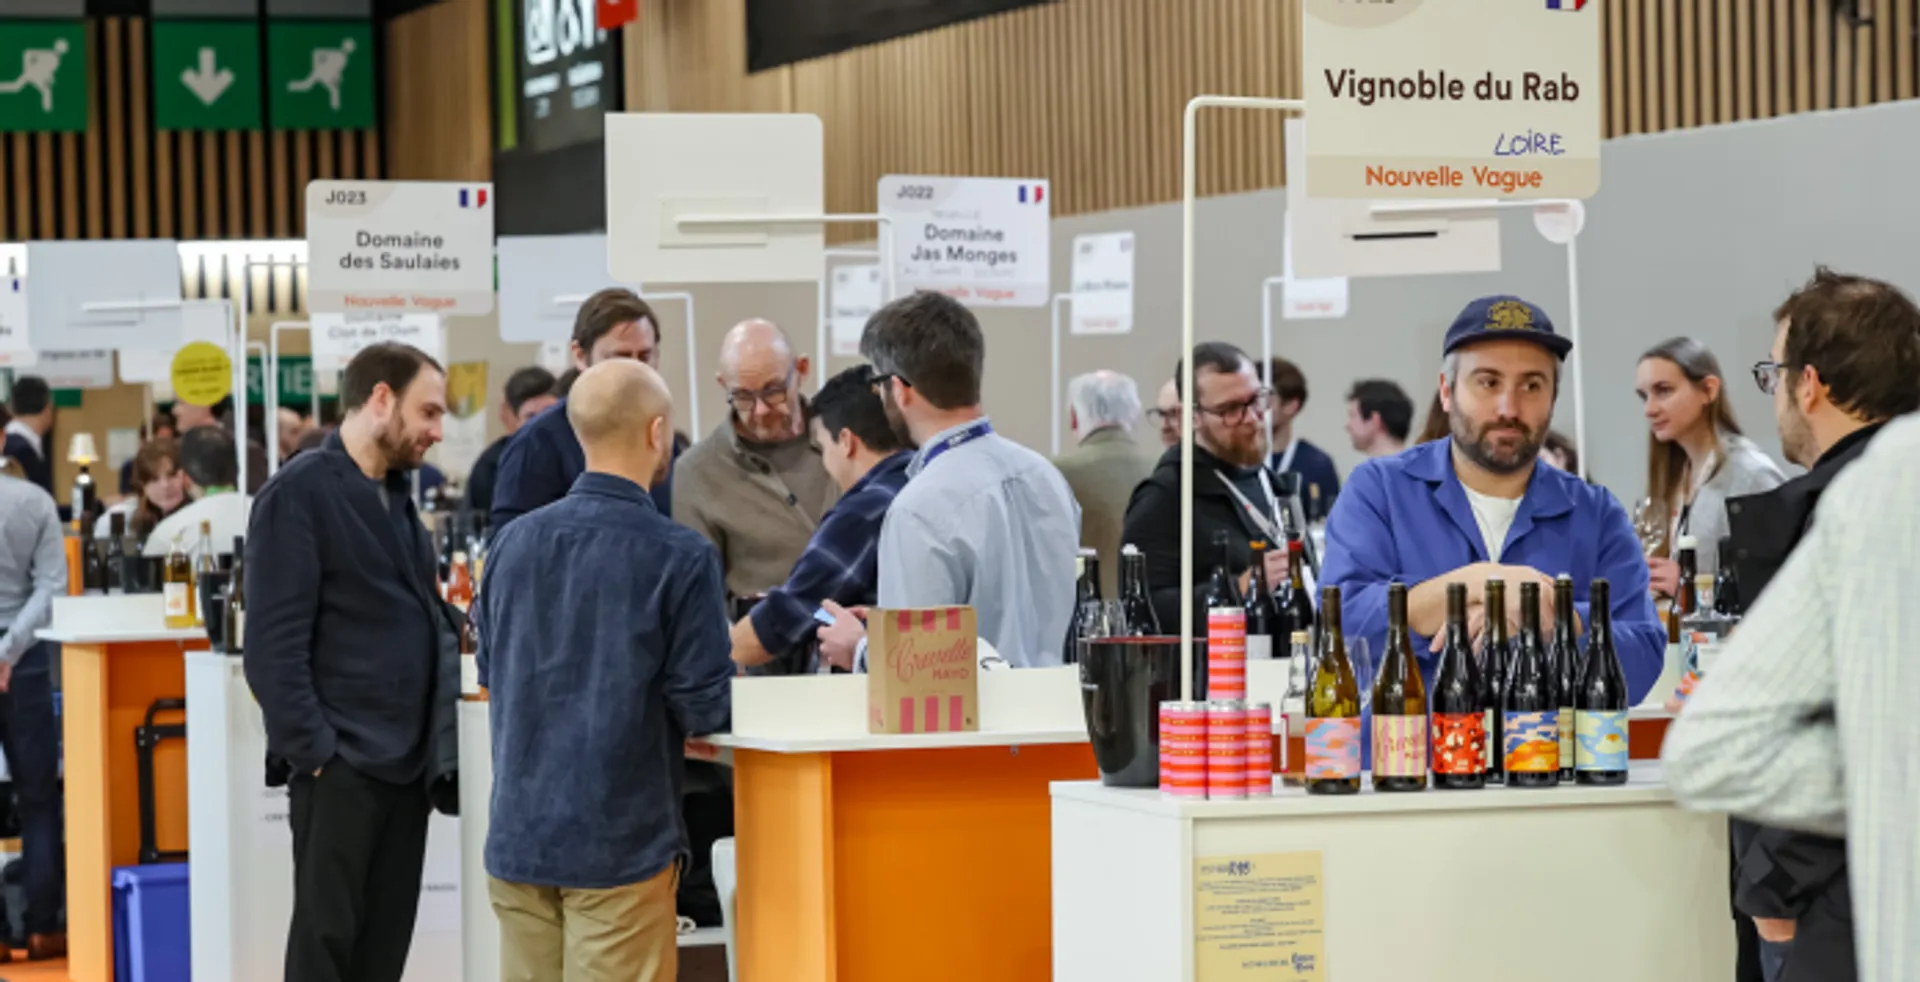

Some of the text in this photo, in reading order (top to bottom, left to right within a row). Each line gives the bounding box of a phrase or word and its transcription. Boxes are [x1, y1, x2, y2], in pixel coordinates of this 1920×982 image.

[1324, 69, 1580, 106] Vignoble du Rab
[1365, 165, 1543, 194] Nouvelle Vague
[325, 190, 368, 205] J023
[897, 185, 934, 200] J022
[356, 230, 444, 249] Domaine
[924, 223, 1005, 242] Domaine
[339, 252, 461, 270] des Saulaies
[911, 245, 1018, 267] Jas Monges
[344, 294, 458, 310] Nouvelle Vague
